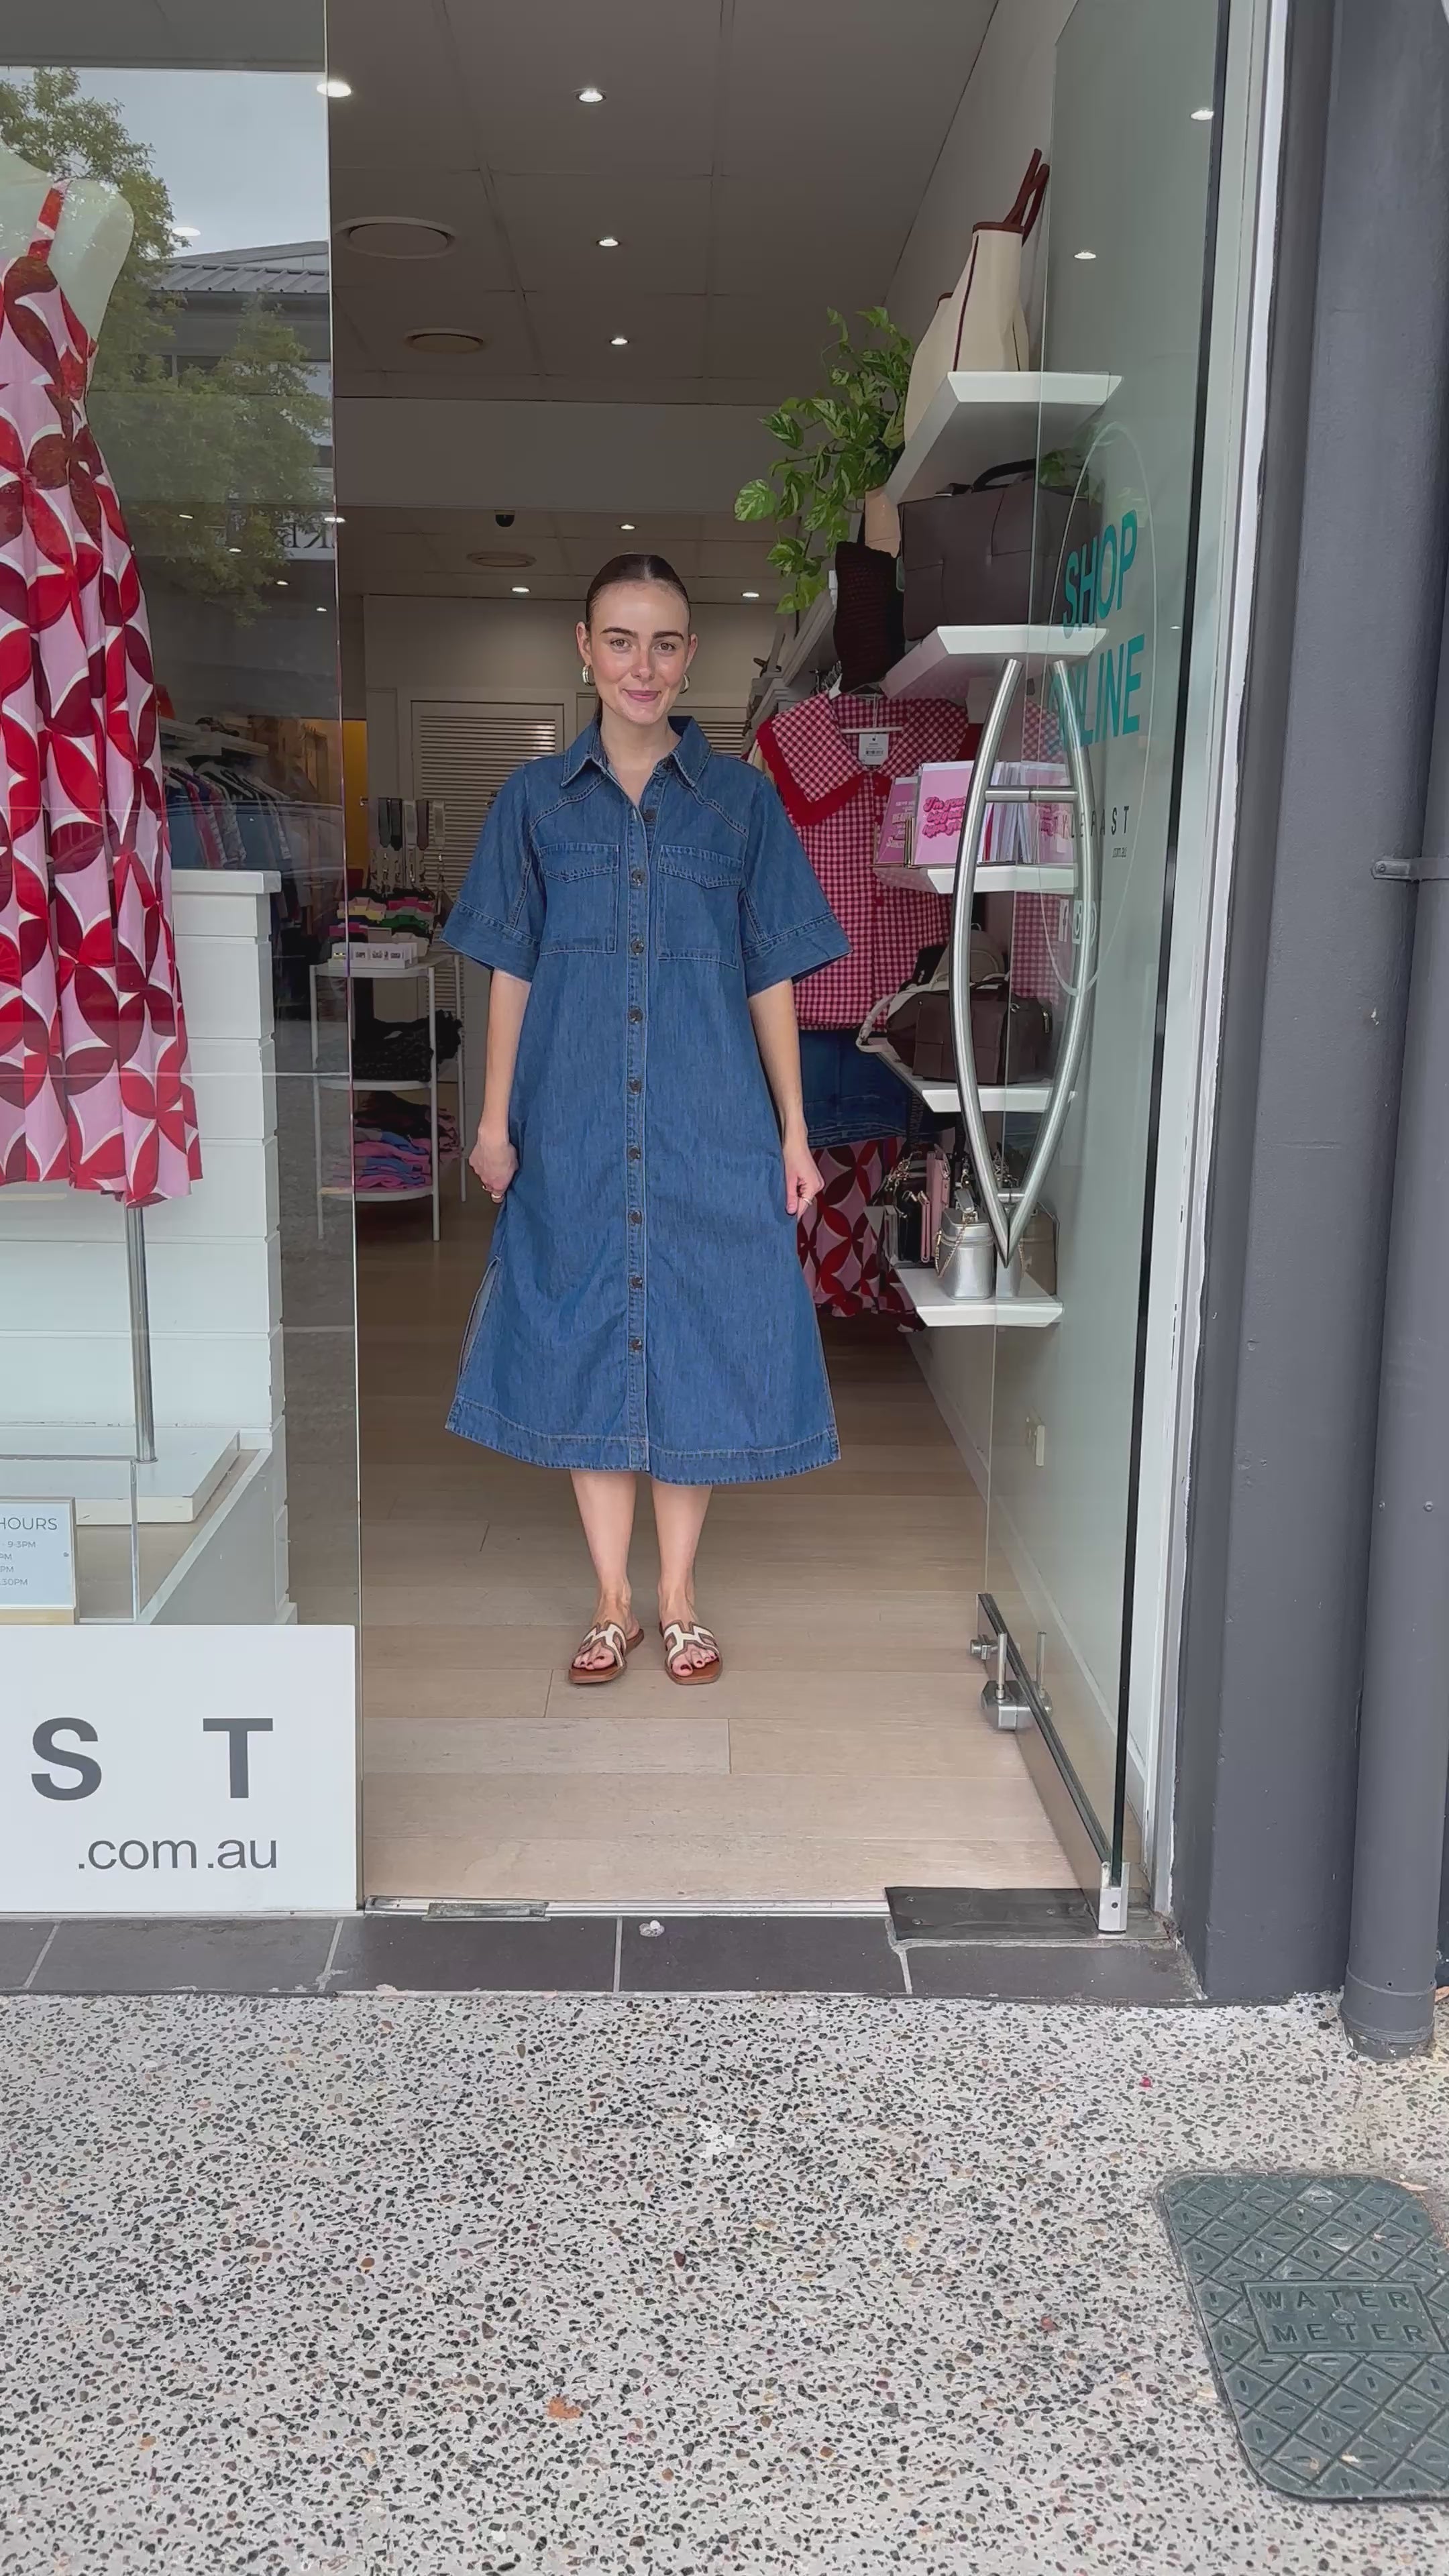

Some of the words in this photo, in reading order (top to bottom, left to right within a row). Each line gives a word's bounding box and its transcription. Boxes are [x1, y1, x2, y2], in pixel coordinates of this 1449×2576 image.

[1063, 509, 1138, 639] SHOP
[1046, 806, 1130, 839] TYLEFAST
[78, 1839, 277, 1870] .com.au
[1258, 2290, 1411, 2312] WATER
[1271, 2322, 1428, 2343] METER
